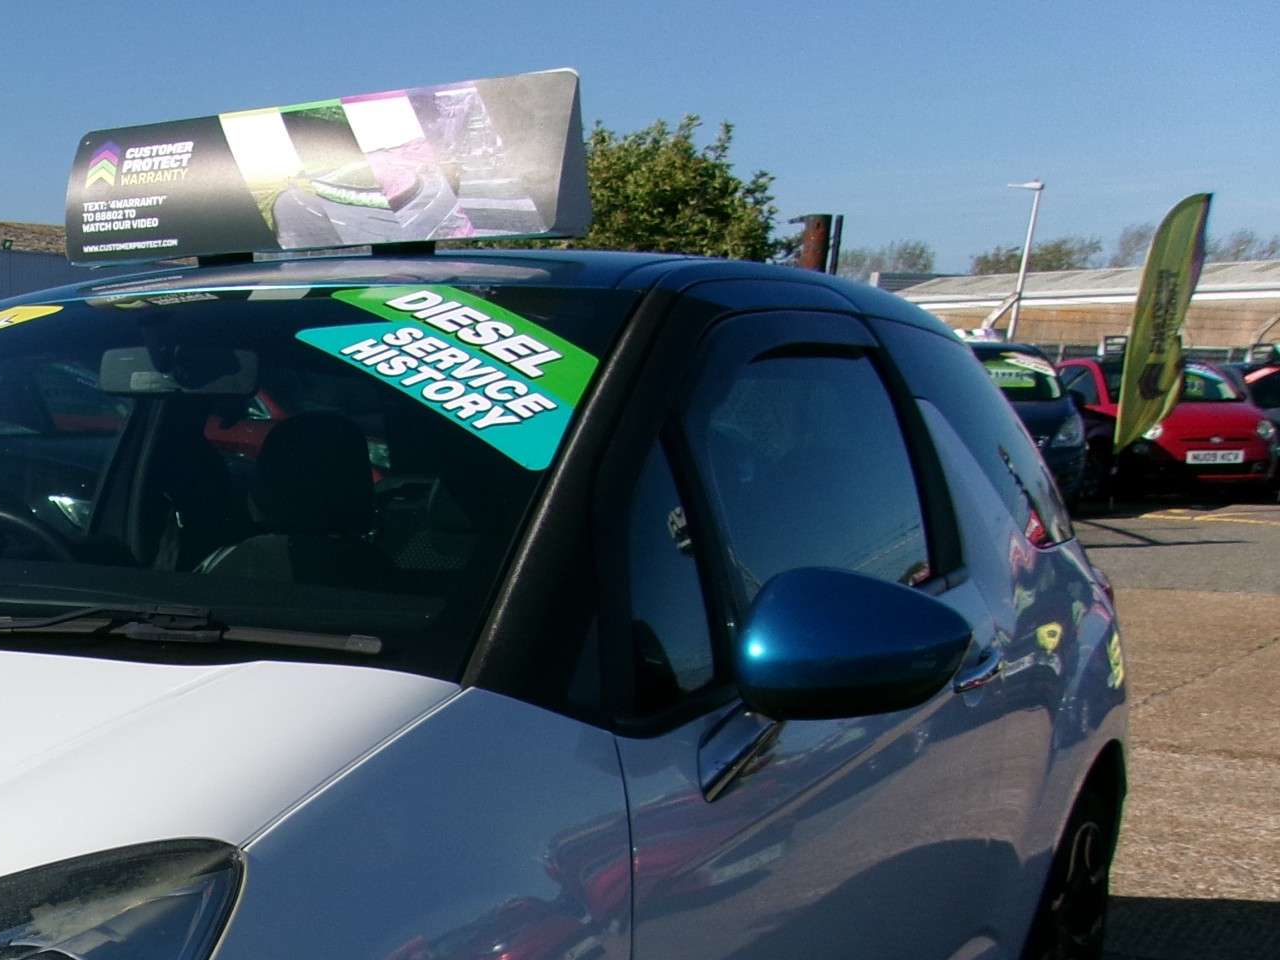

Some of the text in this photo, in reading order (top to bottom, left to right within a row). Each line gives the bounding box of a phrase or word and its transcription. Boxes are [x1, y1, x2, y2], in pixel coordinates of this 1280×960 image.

[125, 141, 194, 159] CUSTOMER
[122, 153, 192, 173] PROTECT
[121, 168, 189, 186] WARRANTY
[82, 212, 94, 222] TO
[124, 209, 136, 219] TO
[83, 202, 107, 212] TEXT:
[82, 218, 159, 233] WATCH OUR VIDEO
[386, 290, 562, 378] DIESEL
[382, 327, 557, 418] SERVICE
[340, 338, 520, 430] HISTORY
